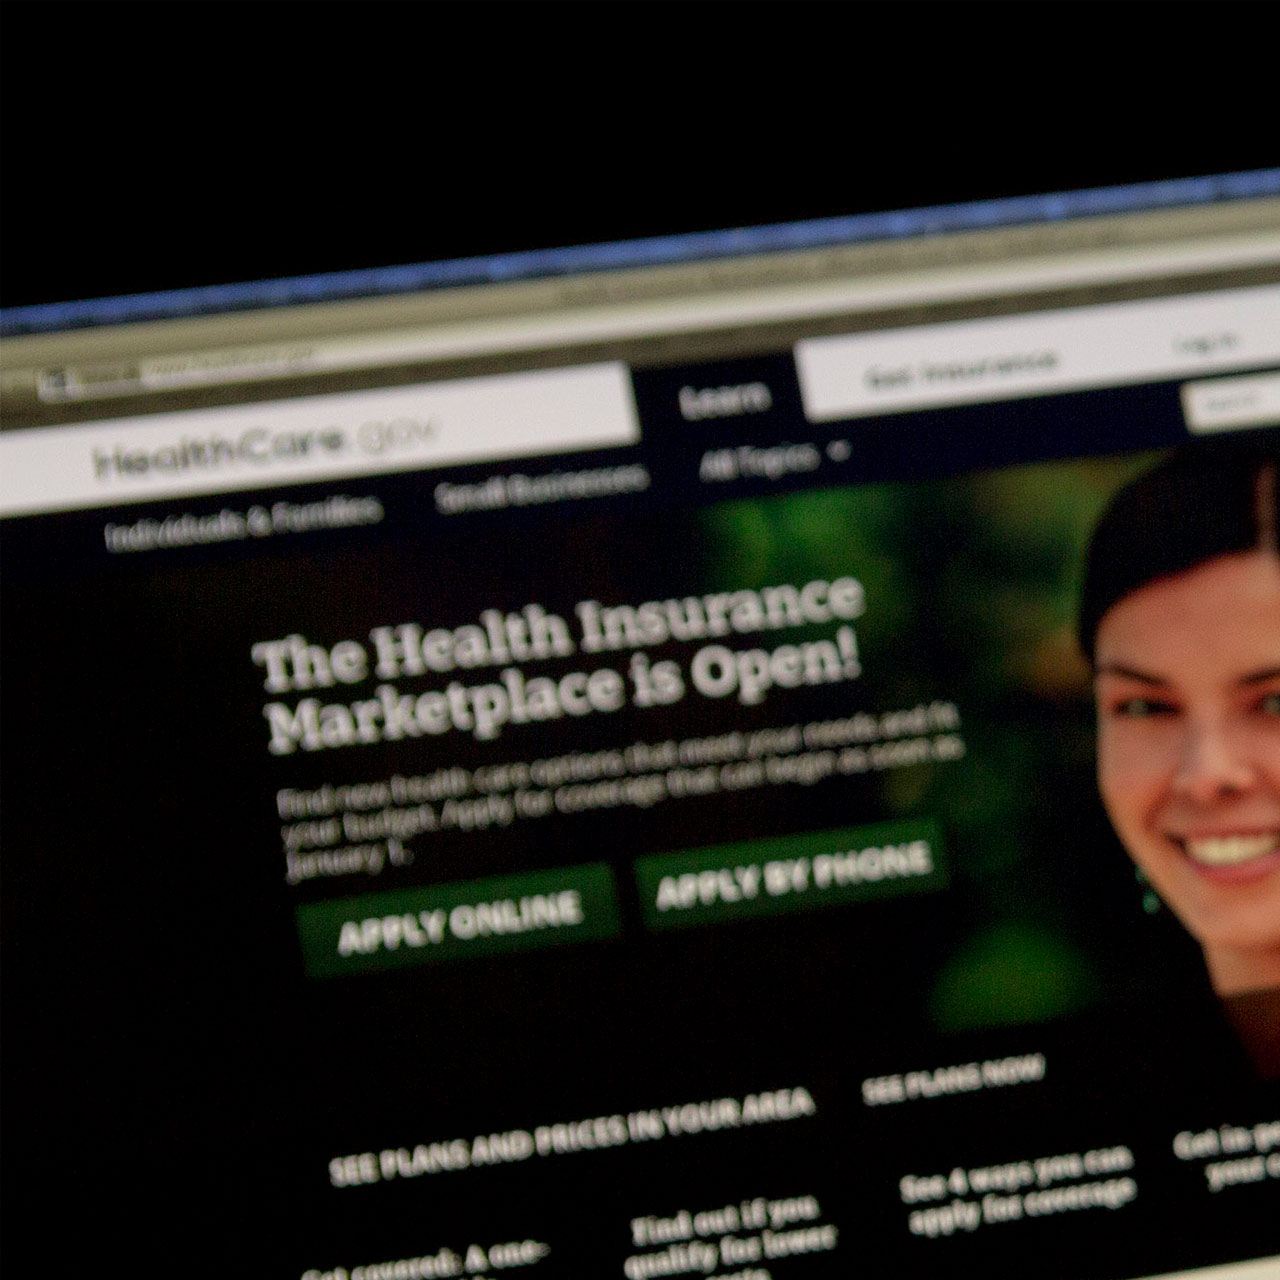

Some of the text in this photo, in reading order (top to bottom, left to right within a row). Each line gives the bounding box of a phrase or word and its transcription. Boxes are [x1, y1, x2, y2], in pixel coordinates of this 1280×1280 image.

[252, 577, 865, 694] The Health Insurance
[263, 624, 862, 756] Marketplace is Open!
[338, 889, 585, 957] APPLY ONLINE
[656, 839, 935, 912] APPLY BY PHONE
[329, 1085, 817, 1188] SEE PLANS AND PRICES IN YOUR AREA
